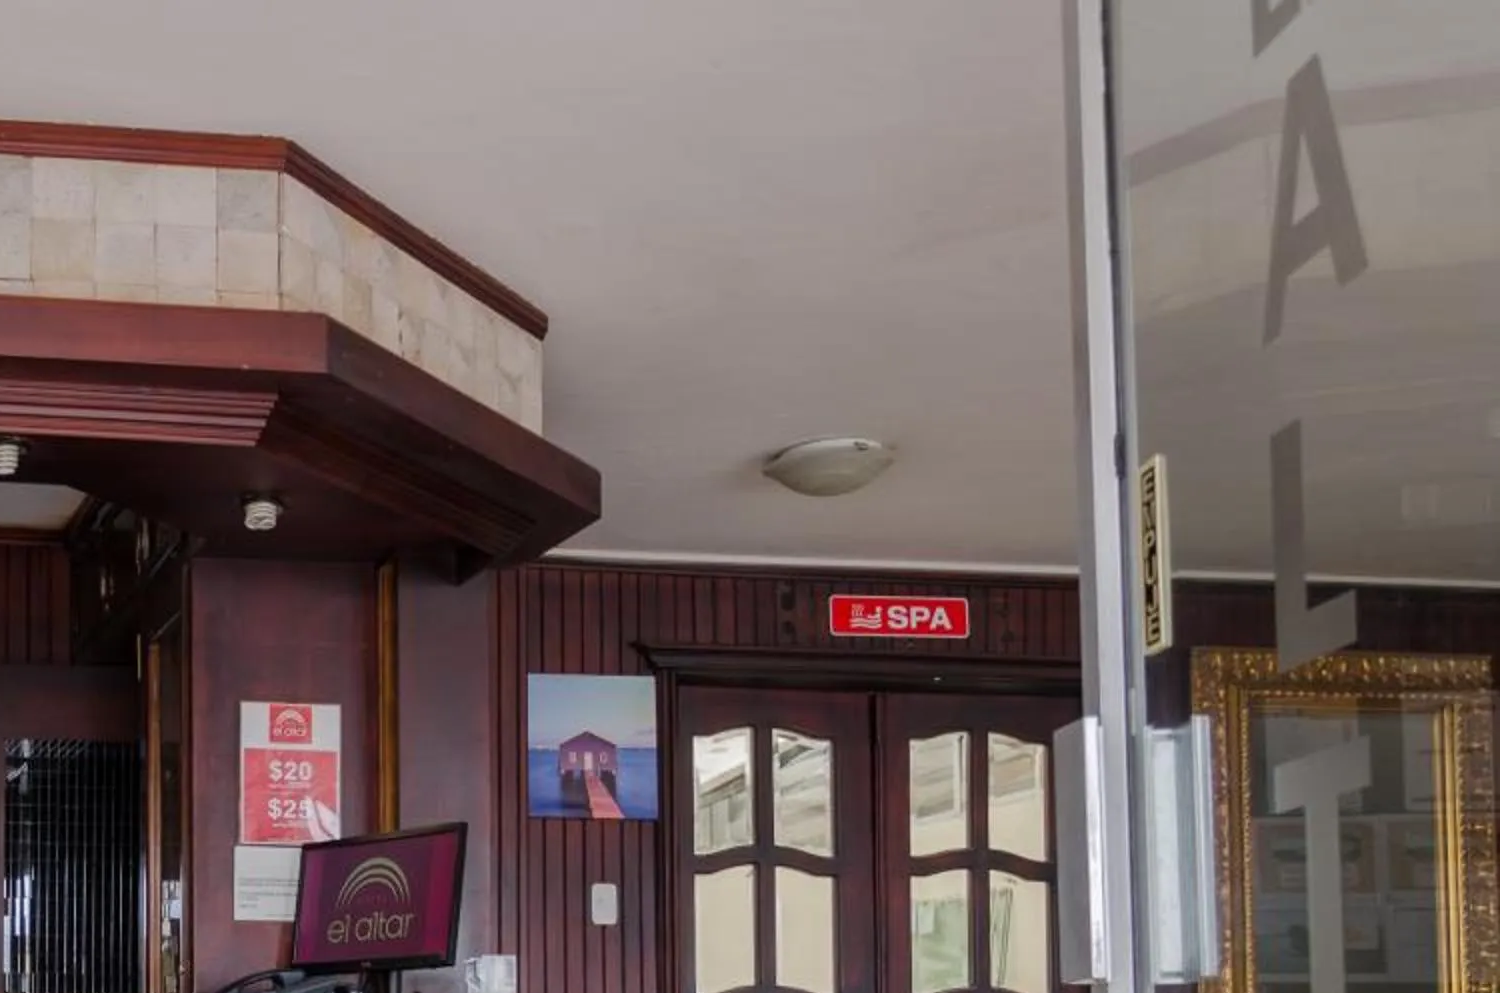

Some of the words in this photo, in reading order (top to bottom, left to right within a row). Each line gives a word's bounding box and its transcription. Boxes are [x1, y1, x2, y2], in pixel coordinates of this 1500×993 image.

[887, 605, 953, 631] SPA
[268, 760, 313, 782] $20
[327, 914, 350, 944] el
[355, 910, 416, 942] altar
